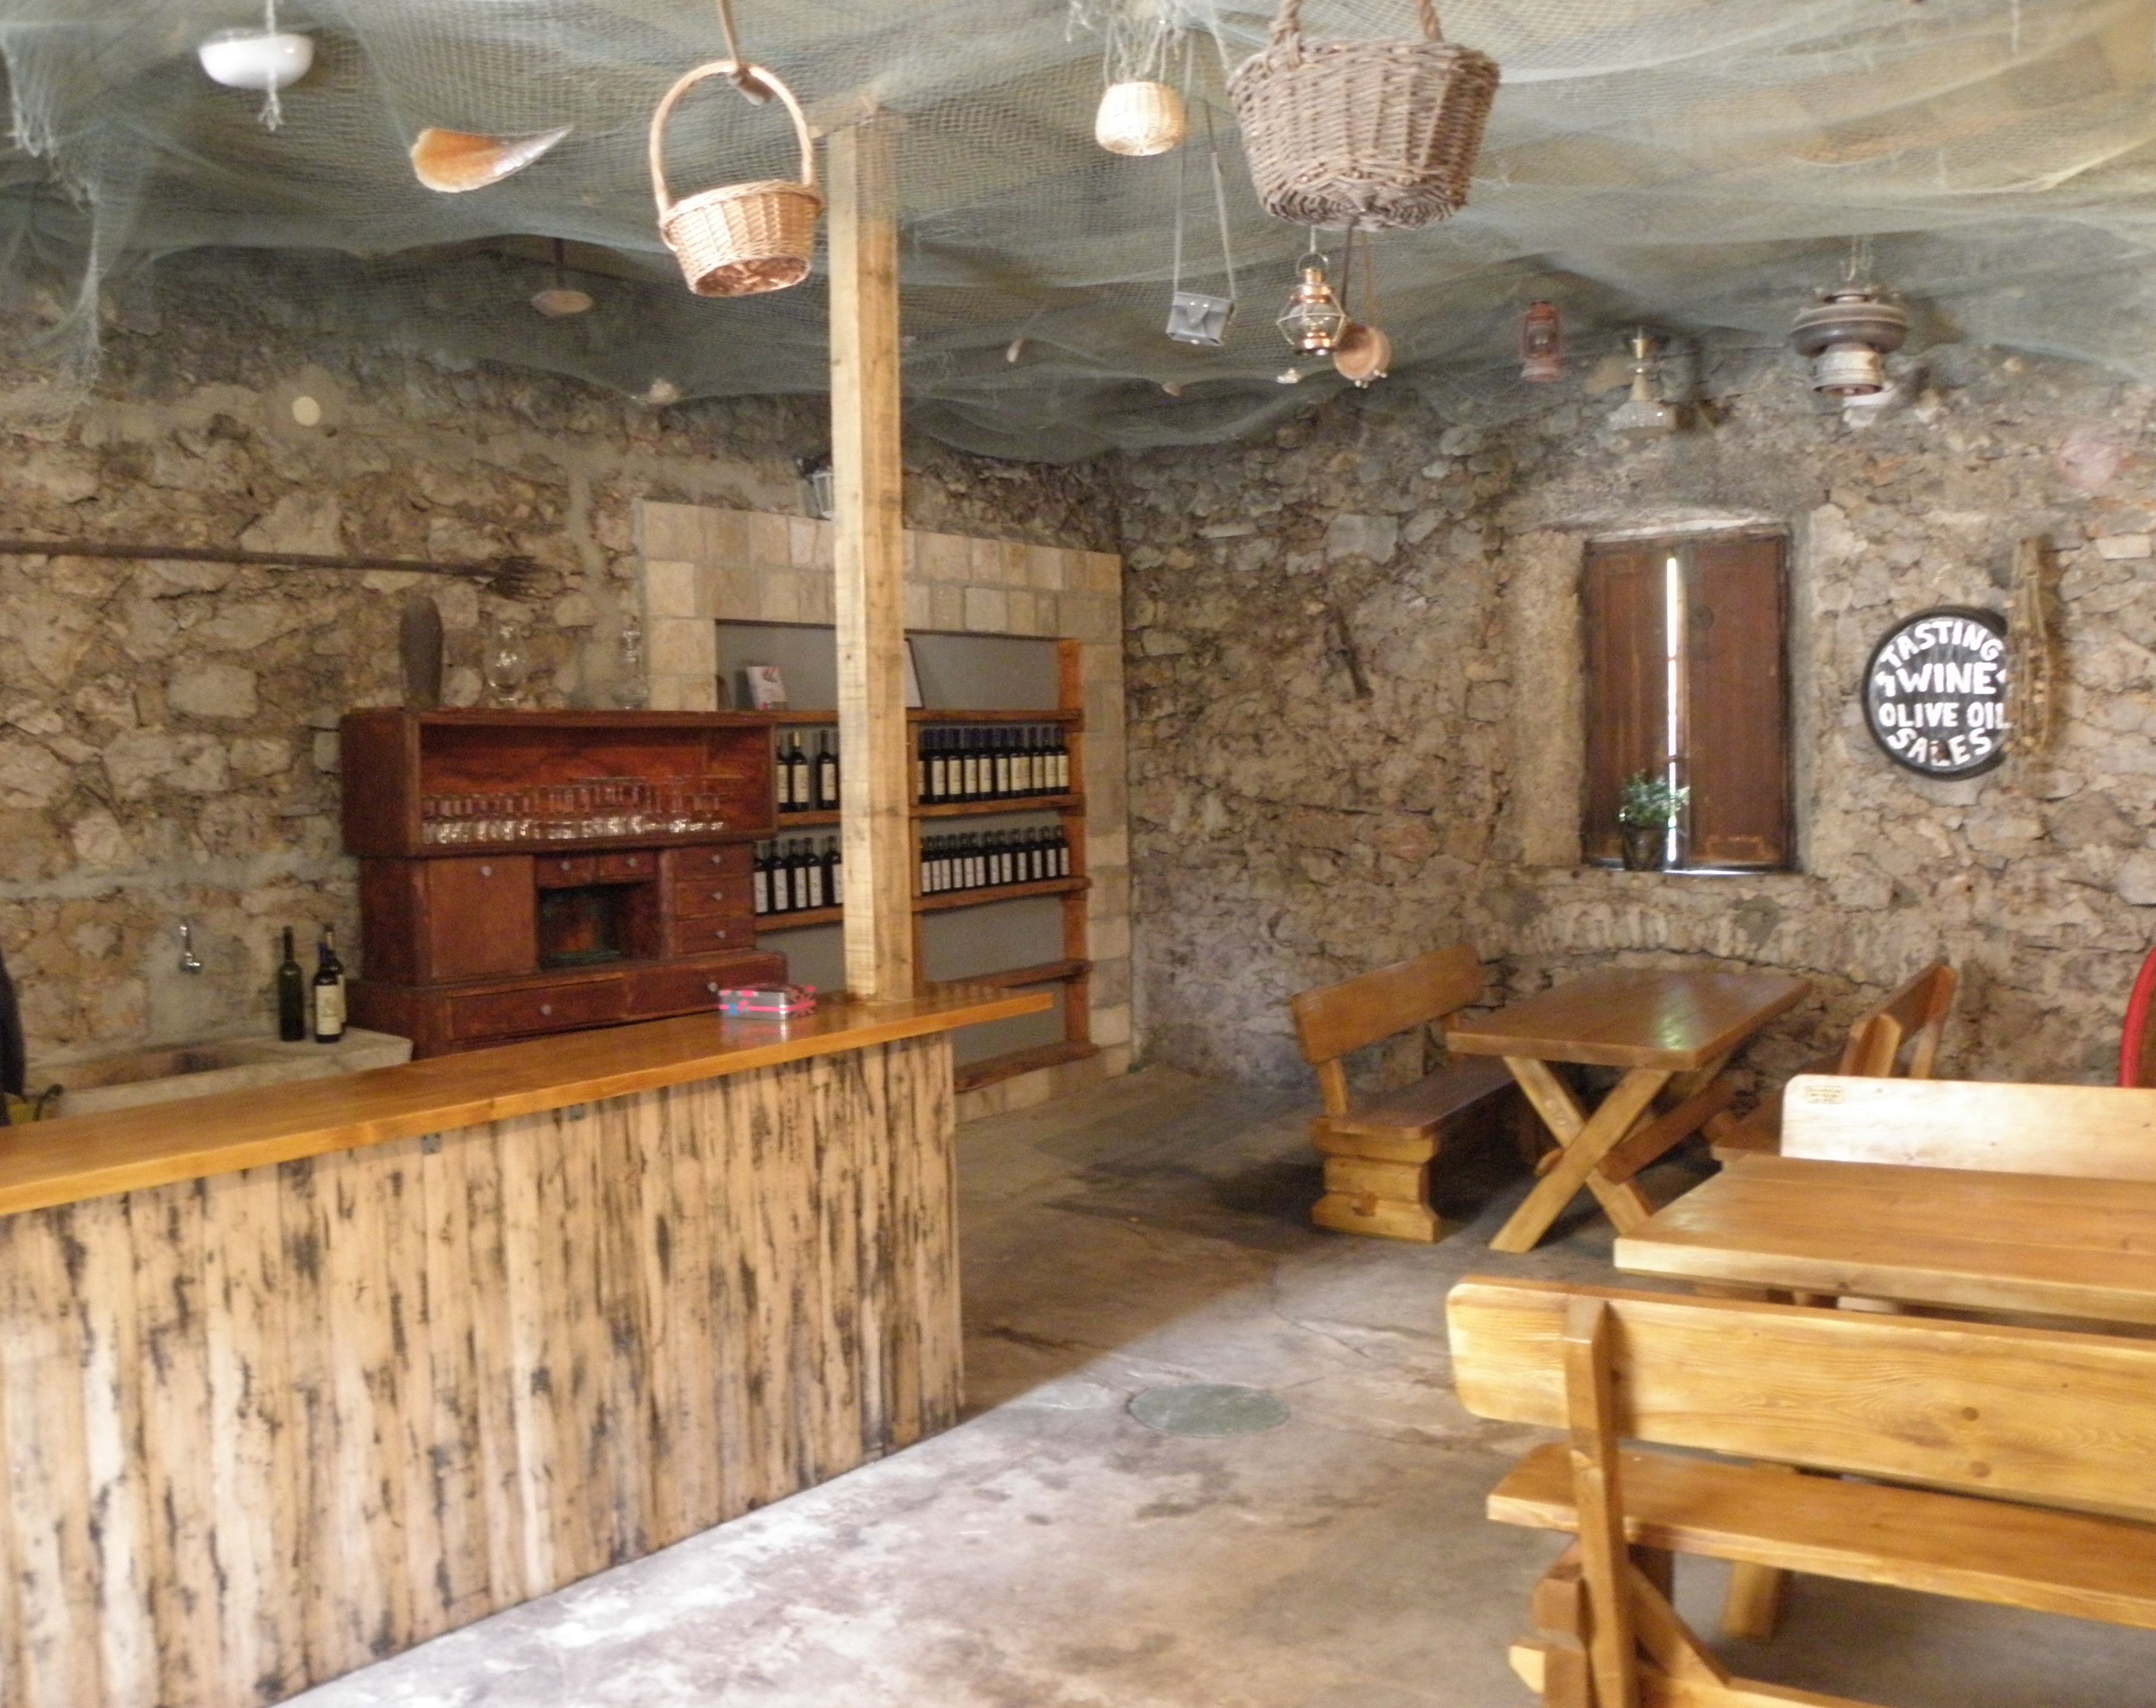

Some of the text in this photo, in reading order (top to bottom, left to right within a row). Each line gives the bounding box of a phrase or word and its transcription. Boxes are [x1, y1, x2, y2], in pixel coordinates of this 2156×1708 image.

[1880, 621, 2004, 668] TASTING
[1896, 662, 1998, 695] WINE
[1878, 702, 2012, 730] OLIVE OIL
[1886, 727, 1993, 767] SALES
